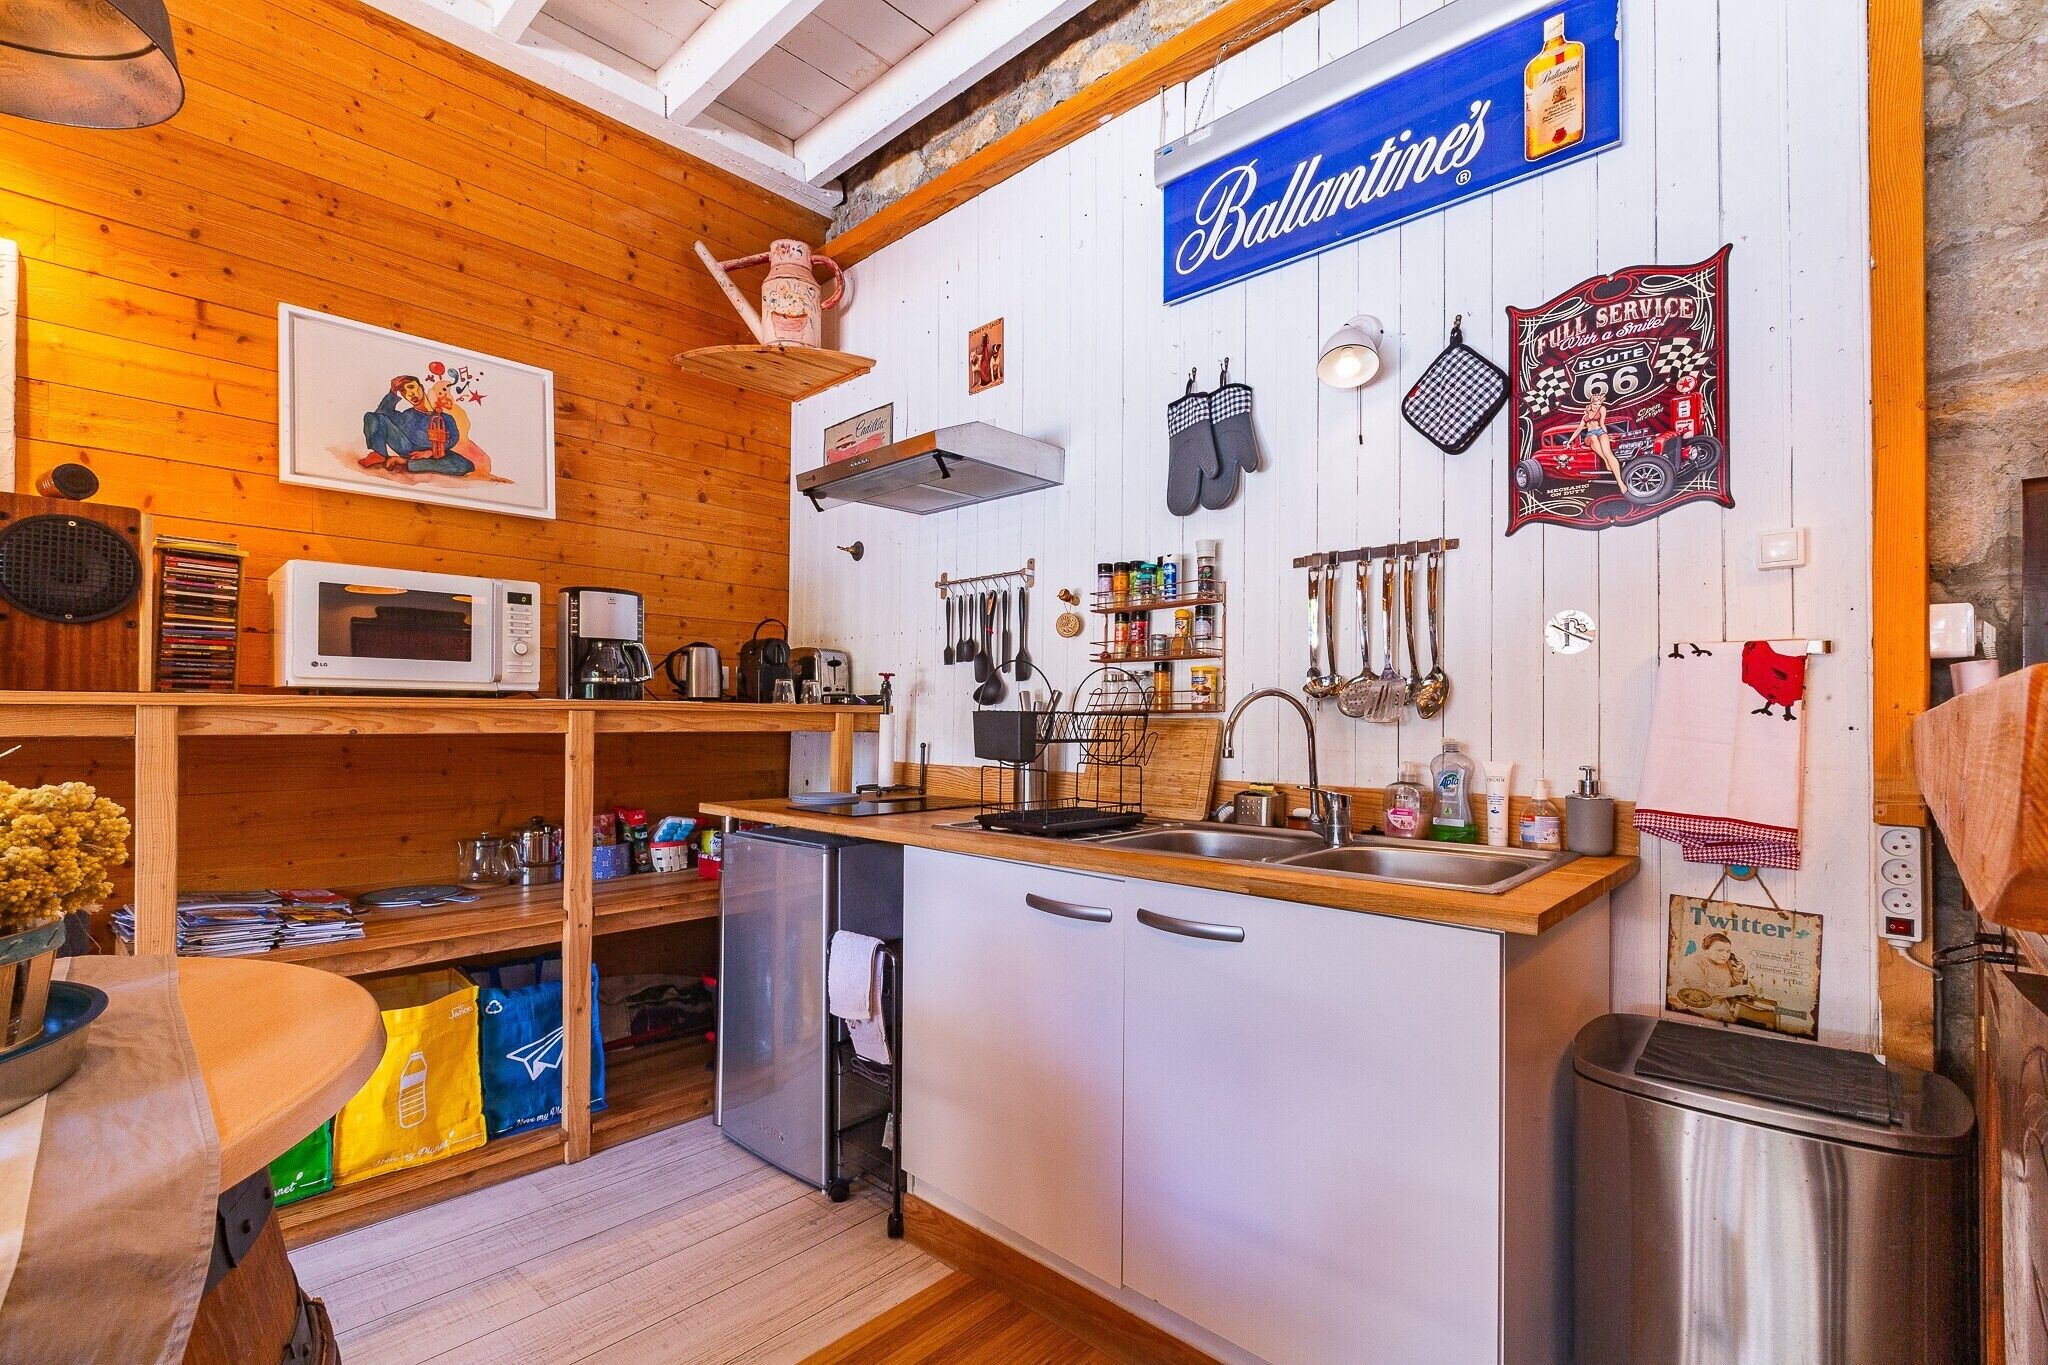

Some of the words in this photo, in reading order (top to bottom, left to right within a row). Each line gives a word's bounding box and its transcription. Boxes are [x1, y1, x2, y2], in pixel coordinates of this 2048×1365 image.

[1176, 100, 1491, 275] Ballantine's
[1536, 315, 1587, 357] FULL
[1595, 296, 1694, 328] SERVICE
[1559, 331, 1598, 350] With
[1602, 331, 1613, 340] a
[1616, 313, 1671, 337] Smile!
[1578, 347, 1644, 371] ROUTE
[1583, 366, 1639, 400] 66
[855, 416, 887, 438] Cadillac
[1563, 488, 1586, 496] DUTY
[1689, 906, 1792, 939] Twitter
